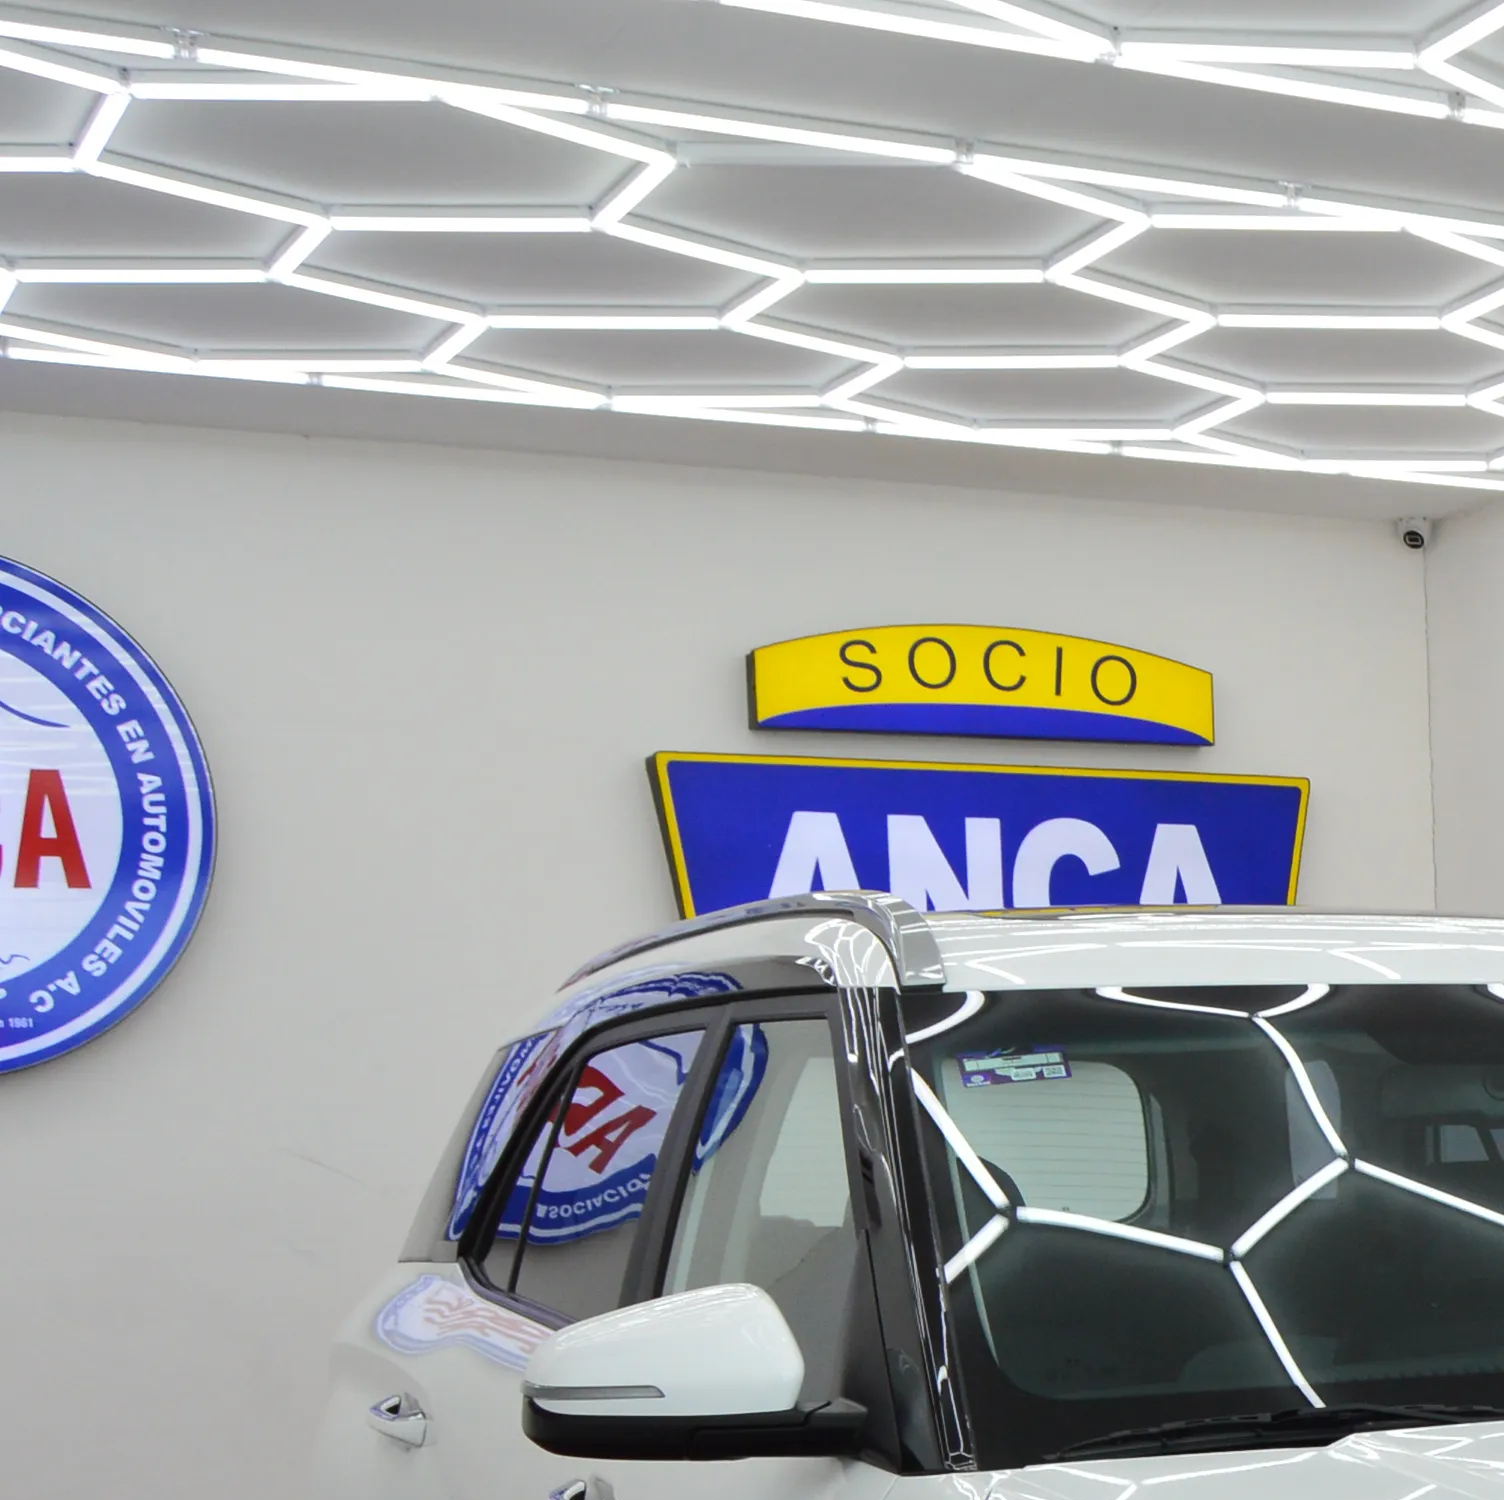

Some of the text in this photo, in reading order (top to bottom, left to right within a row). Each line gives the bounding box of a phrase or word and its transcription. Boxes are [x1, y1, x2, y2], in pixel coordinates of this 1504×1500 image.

[0, 605, 128, 716] CIANTES
[838, 636, 1138, 706] SOCIO
[115, 719, 156, 764] EN
[82, 772, 167, 977] AUTOMOVILES
[768, 810, 1221, 911] ANCA
